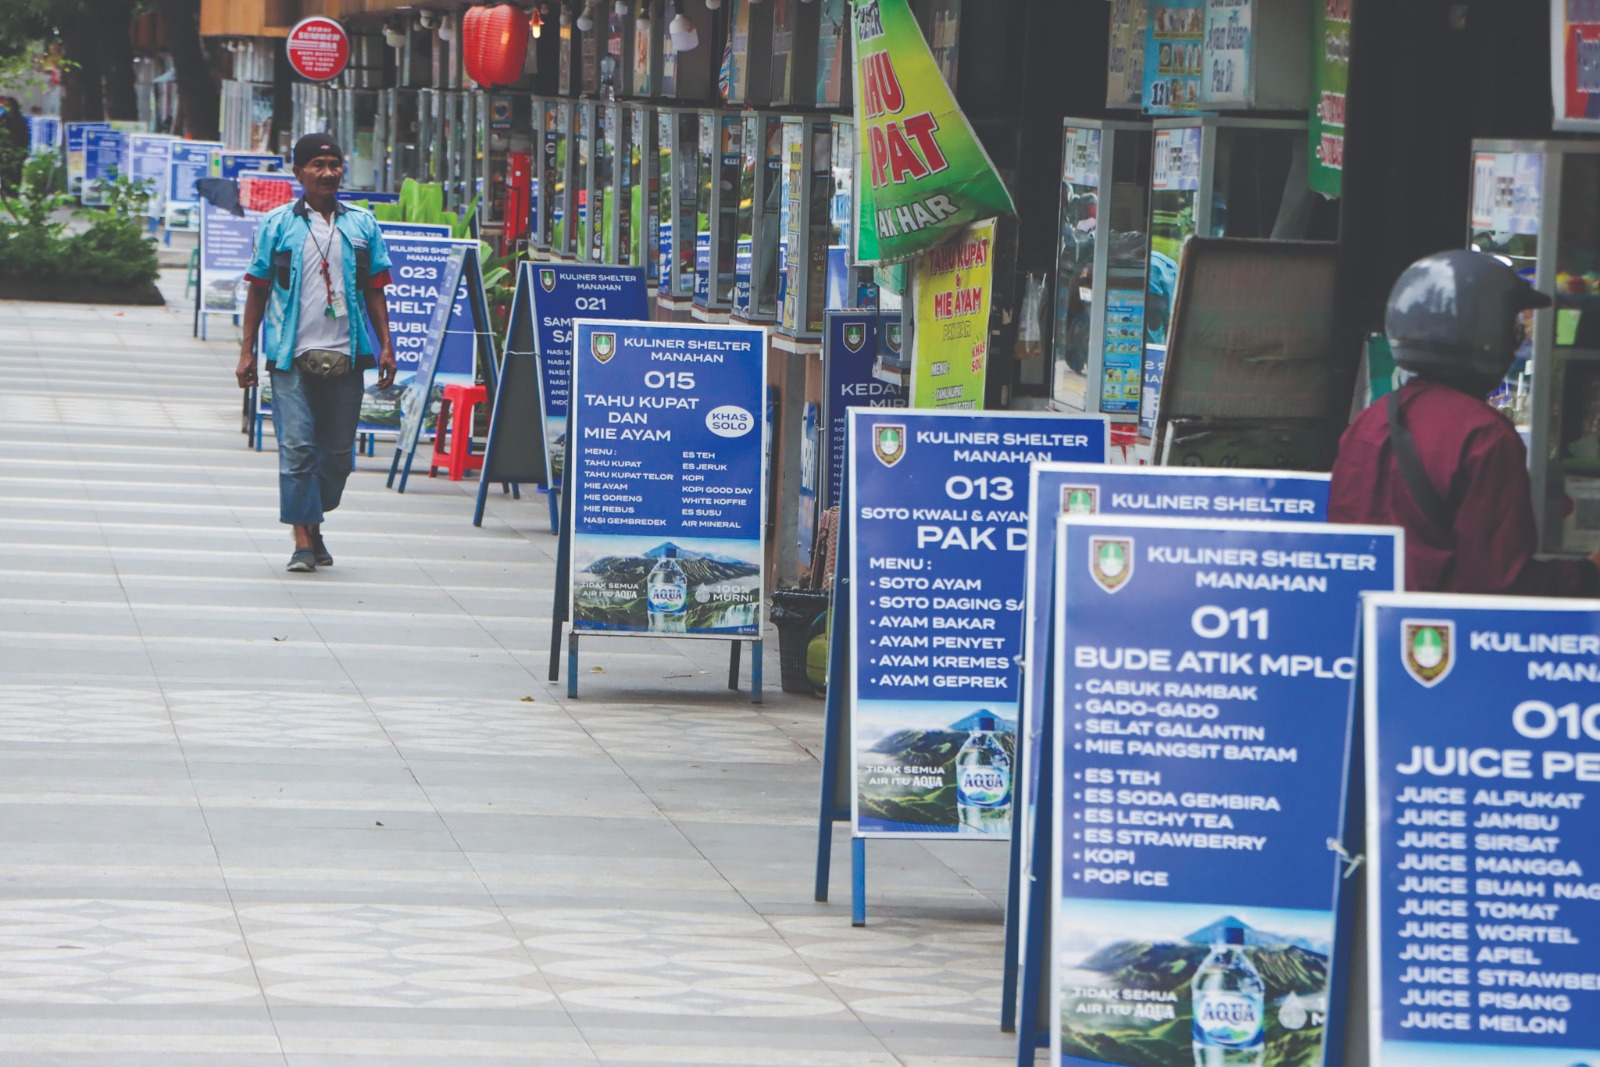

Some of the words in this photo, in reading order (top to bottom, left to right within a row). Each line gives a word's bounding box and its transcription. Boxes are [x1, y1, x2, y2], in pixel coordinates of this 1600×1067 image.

[896, 194, 961, 235] HAR
[390, 245, 429, 253] KULINER
[956, 239, 988, 271] KUPAT
[400, 266, 437, 279] 023
[575, 297, 606, 310] 021
[934, 290, 953, 319] MIE
[954, 287, 982, 317] AYAM
[624, 338, 684, 349] KULINER
[688, 340, 751, 351] SHELTER
[651, 352, 723, 363] MANAHAN
[644, 371, 695, 389] 015
[584, 395, 634, 407] TAHU
[639, 397, 699, 409] KUPAT
[608, 412, 647, 424] DAN
[712, 422, 747, 430] SOLO
[713, 413, 747, 421] KHAS
[585, 428, 616, 440] MIE
[620, 429, 670, 441] AYAM
[917, 431, 999, 445] KULINER
[1003, 433, 1088, 447] SHELTER
[585, 448, 613, 456] MENU
[954, 450, 1052, 464] MANAHAN
[612, 472, 643, 480] KUPAT
[643, 473, 673, 481] TELOR
[945, 475, 1014, 501] 013
[682, 497, 712, 505] WHITE
[713, 498, 747, 506] KOFFIE
[1112, 493, 1211, 511] KULINER
[1213, 496, 1315, 515] SHELTER
[607, 517, 666, 526] GEMBREDEK
[861, 507, 909, 520] SOTO
[913, 509, 967, 521] KWALI
[971, 510, 983, 522] &
[699, 521, 741, 529] MINERAL
[917, 526, 996, 550] PAK
[870, 557, 924, 570] MENU
[1148, 546, 1256, 566] KULINER
[1262, 549, 1376, 571] SHELTER
[716, 585, 750, 594] 100%
[879, 577, 929, 589] SOTO
[932, 579, 981, 590] AYAM
[1196, 571, 1327, 592] MANAHAN
[615, 591, 637, 600] AQUA
[653, 589, 682, 601] AQUA
[713, 593, 753, 602] MURNI
[879, 596, 929, 609] SOTO
[933, 598, 1002, 610] DAGING
[879, 616, 928, 628] AYAM
[933, 617, 995, 630] BAKAR
[1191, 605, 1269, 640] 011
[879, 636, 928, 648] AYAM
[933, 637, 1005, 649] PENYET
[879, 655, 928, 667] AYAM
[933, 656, 1009, 669] KREMES
[1074, 646, 1172, 672] BUDE
[1176, 651, 1253, 676] ATIK
[879, 675, 928, 686] AYAM
[933, 676, 1008, 688] GEPREK
[1085, 679, 1160, 696] CABUK
[1164, 682, 1258, 701] RAMBAK
[1085, 698, 1219, 719] GADO-GADO
[1085, 718, 1153, 736] SELAT
[1155, 722, 1265, 741] GALANTIN
[1085, 739, 1124, 755] MIE
[1127, 740, 1221, 760] PANGSIT
[1224, 745, 1297, 763] BATAM
[866, 766, 901, 774] TIDAK
[903, 766, 945, 774] SEMUA
[1396, 745, 1533, 779] JUICE
[869, 777, 888, 785] AIR
[891, 777, 910, 785] ITU
[913, 776, 943, 789] AQUA
[964, 772, 1003, 790] AQUA
[1084, 768, 1114, 784] ES
[1116, 769, 1160, 786] TEH
[1084, 788, 1114, 804] ES
[1117, 790, 1178, 807] SODA
[1180, 792, 1281, 812] GEMBIRA
[1396, 786, 1466, 805] JUICE
[1473, 789, 1584, 809] ALPUKAT
[1084, 808, 1114, 824] ES
[1117, 810, 1188, 827] LECHY
[1190, 812, 1234, 830] TEA
[1396, 809, 1467, 827] JUICE
[1474, 812, 1559, 831] JAMBU
[1084, 828, 1114, 844] ES
[1116, 829, 1267, 851] STRAWBERRY
[1397, 831, 1467, 850] JUICE
[1474, 833, 1560, 853] SIRSAT
[1084, 848, 1135, 865] KOPI
[1397, 854, 1467, 872] JUICE
[1475, 856, 1583, 877] MANGGA
[1084, 868, 1130, 884] POP
[1134, 870, 1169, 887] ICE
[1397, 876, 1468, 894] JUICE
[1476, 878, 1545, 898] BUAH
[1398, 898, 1468, 917] JUICE
[1474, 901, 1560, 921] TOMAT
[1398, 921, 1469, 940] JUICE
[1476, 924, 1580, 944] WORTEL
[1398, 943, 1469, 962] JUICE
[1476, 946, 1542, 965] APEL
[1399, 966, 1470, 985] JUICE
[1122, 989, 1178, 1002] SEMUA
[1400, 989, 1470, 1008] JUICE
[1478, 991, 1572, 1012] PISANG
[1076, 1003, 1103, 1015] AIR
[1133, 1004, 1176, 1022] AQUA
[1202, 1002, 1255, 1025] AQUA
[1400, 1011, 1471, 1030] JUICE
[1479, 1014, 1567, 1034] MELON
